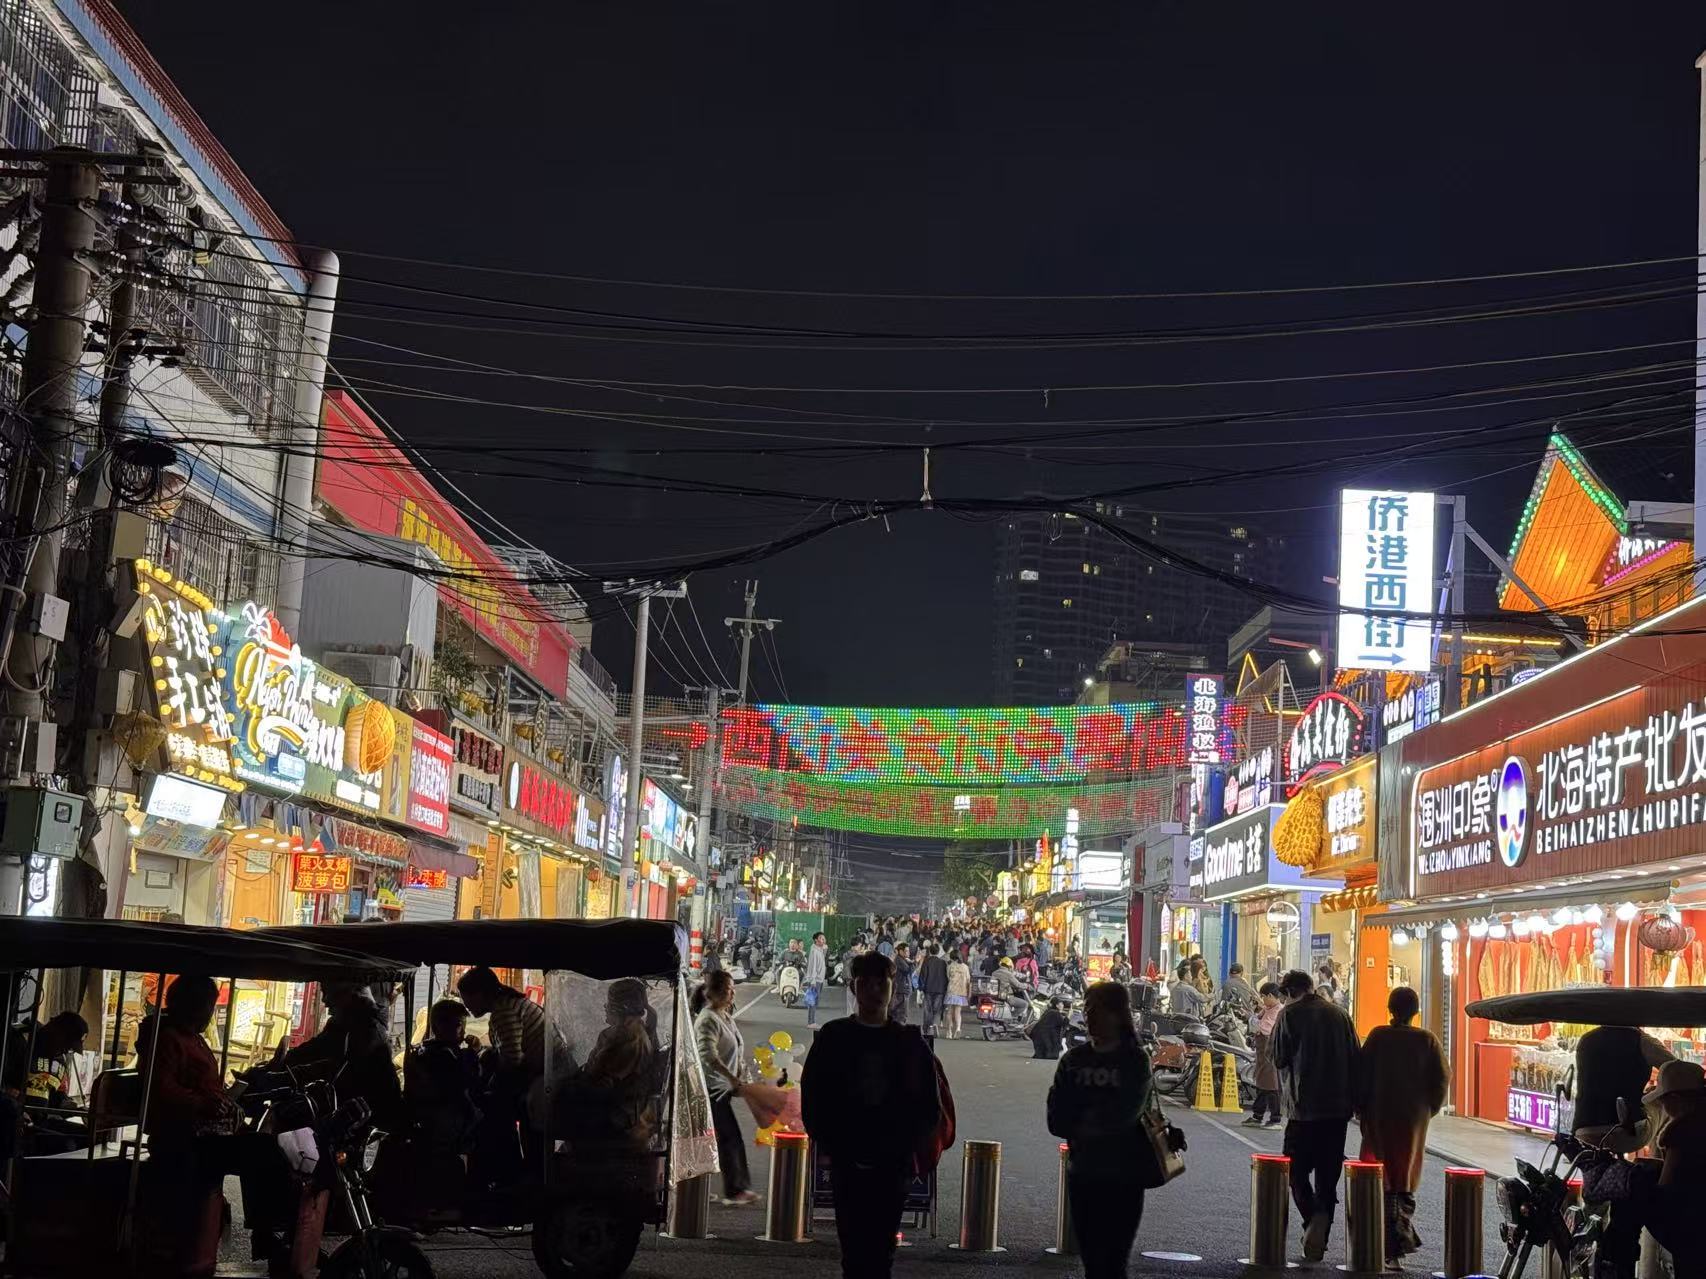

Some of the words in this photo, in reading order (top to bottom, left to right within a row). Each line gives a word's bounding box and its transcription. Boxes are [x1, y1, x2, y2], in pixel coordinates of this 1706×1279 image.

[1365, 495, 1409, 649] 侨港西街
[1536, 700, 1706, 821] 北海特产批发
[297, 872, 346, 890] 菠萝包
